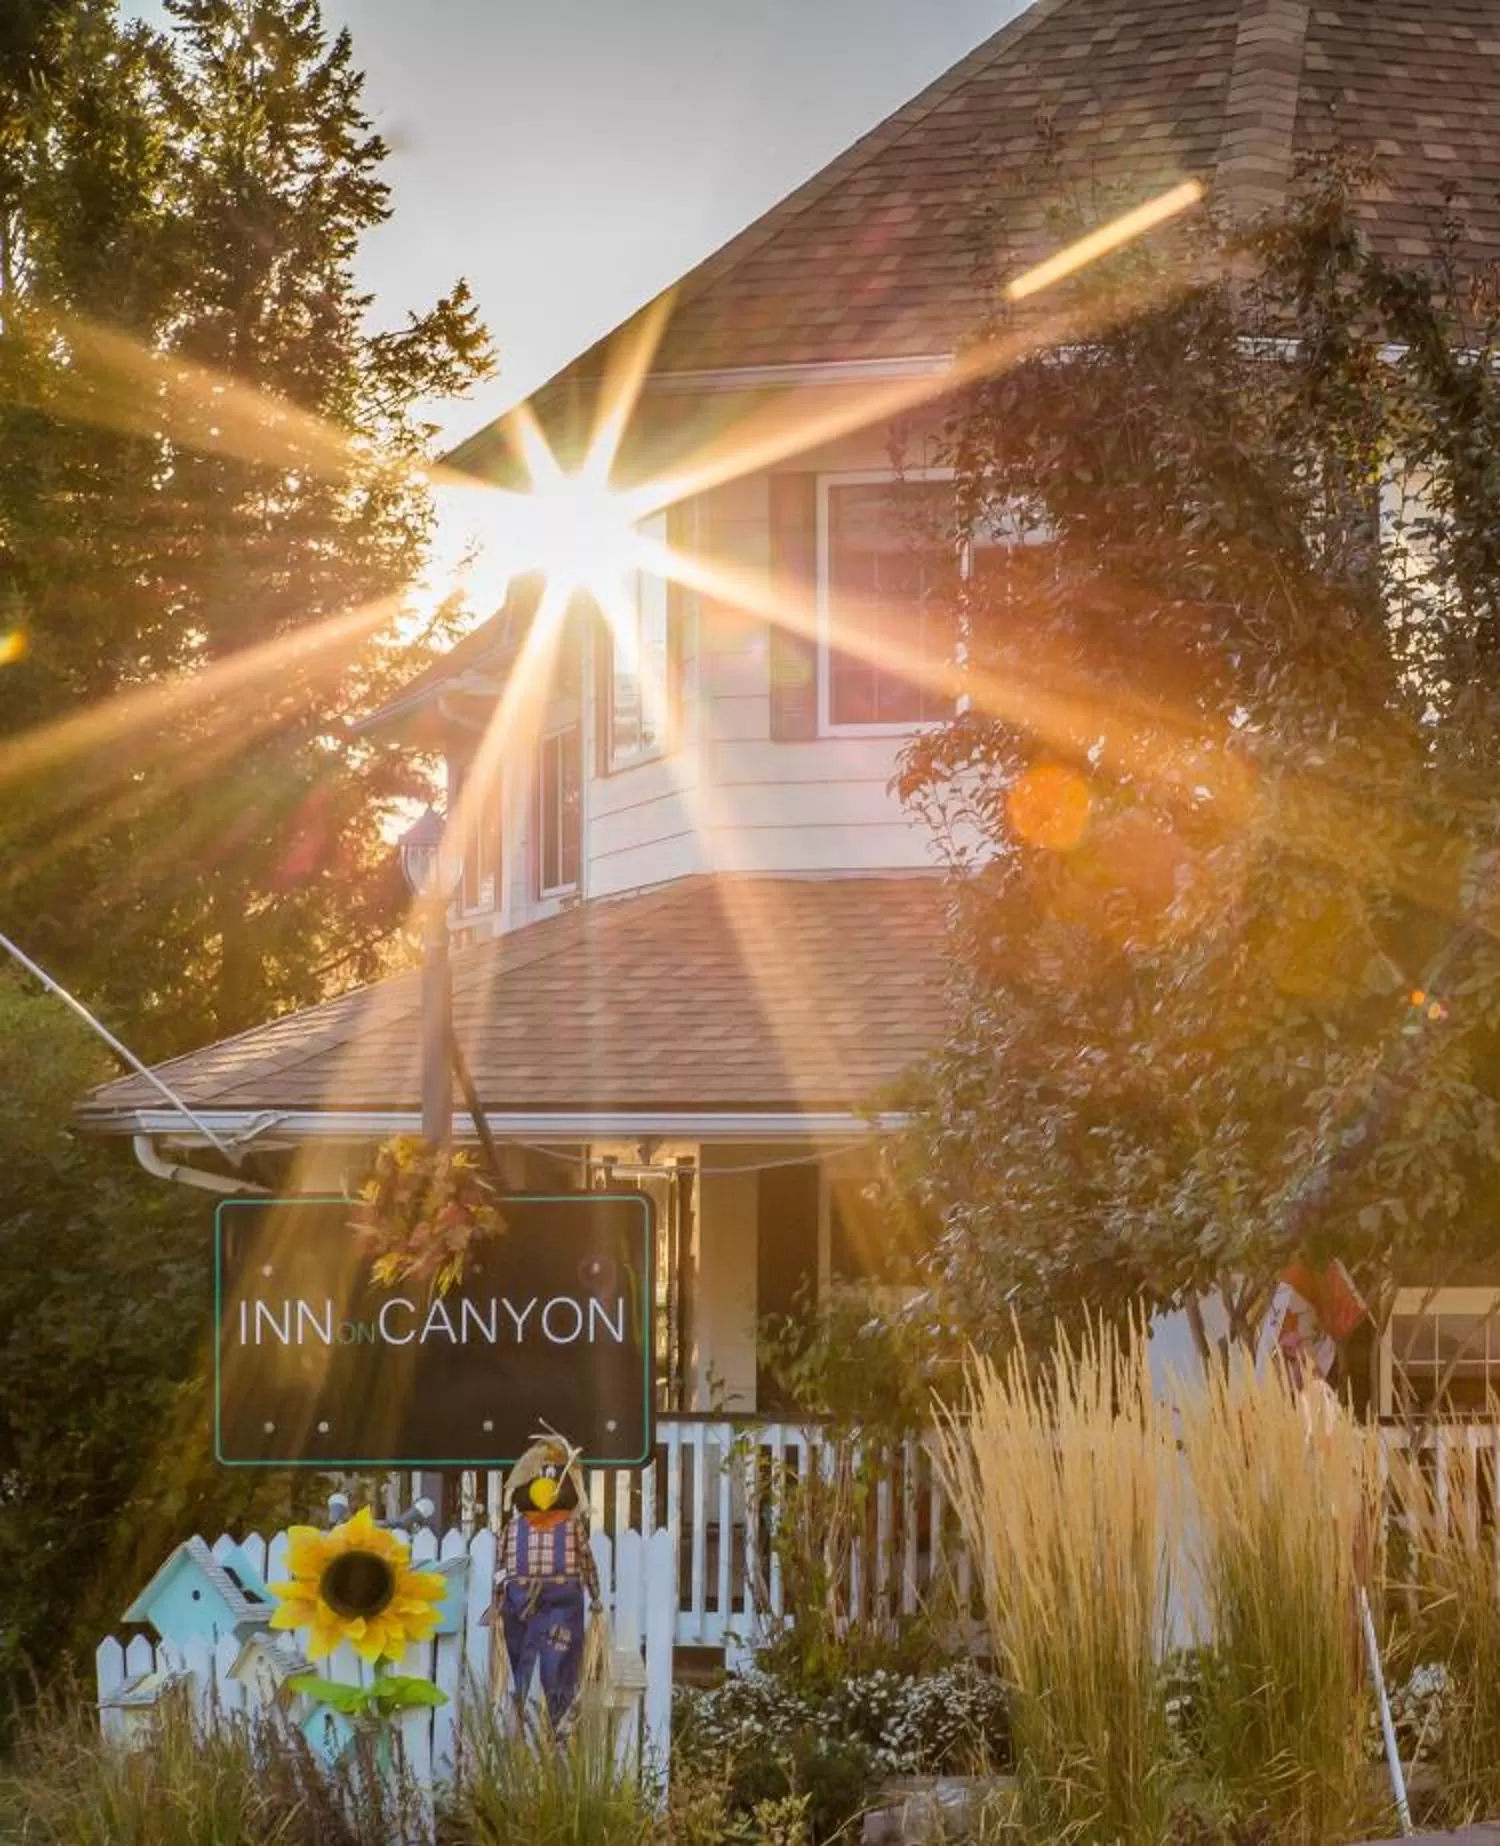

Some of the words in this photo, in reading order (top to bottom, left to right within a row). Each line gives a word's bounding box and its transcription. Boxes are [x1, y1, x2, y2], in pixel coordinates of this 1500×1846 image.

[239, 1298, 332, 1345] INN
[337, 1322, 376, 1345] ON
[379, 1297, 625, 1344] CANYON
